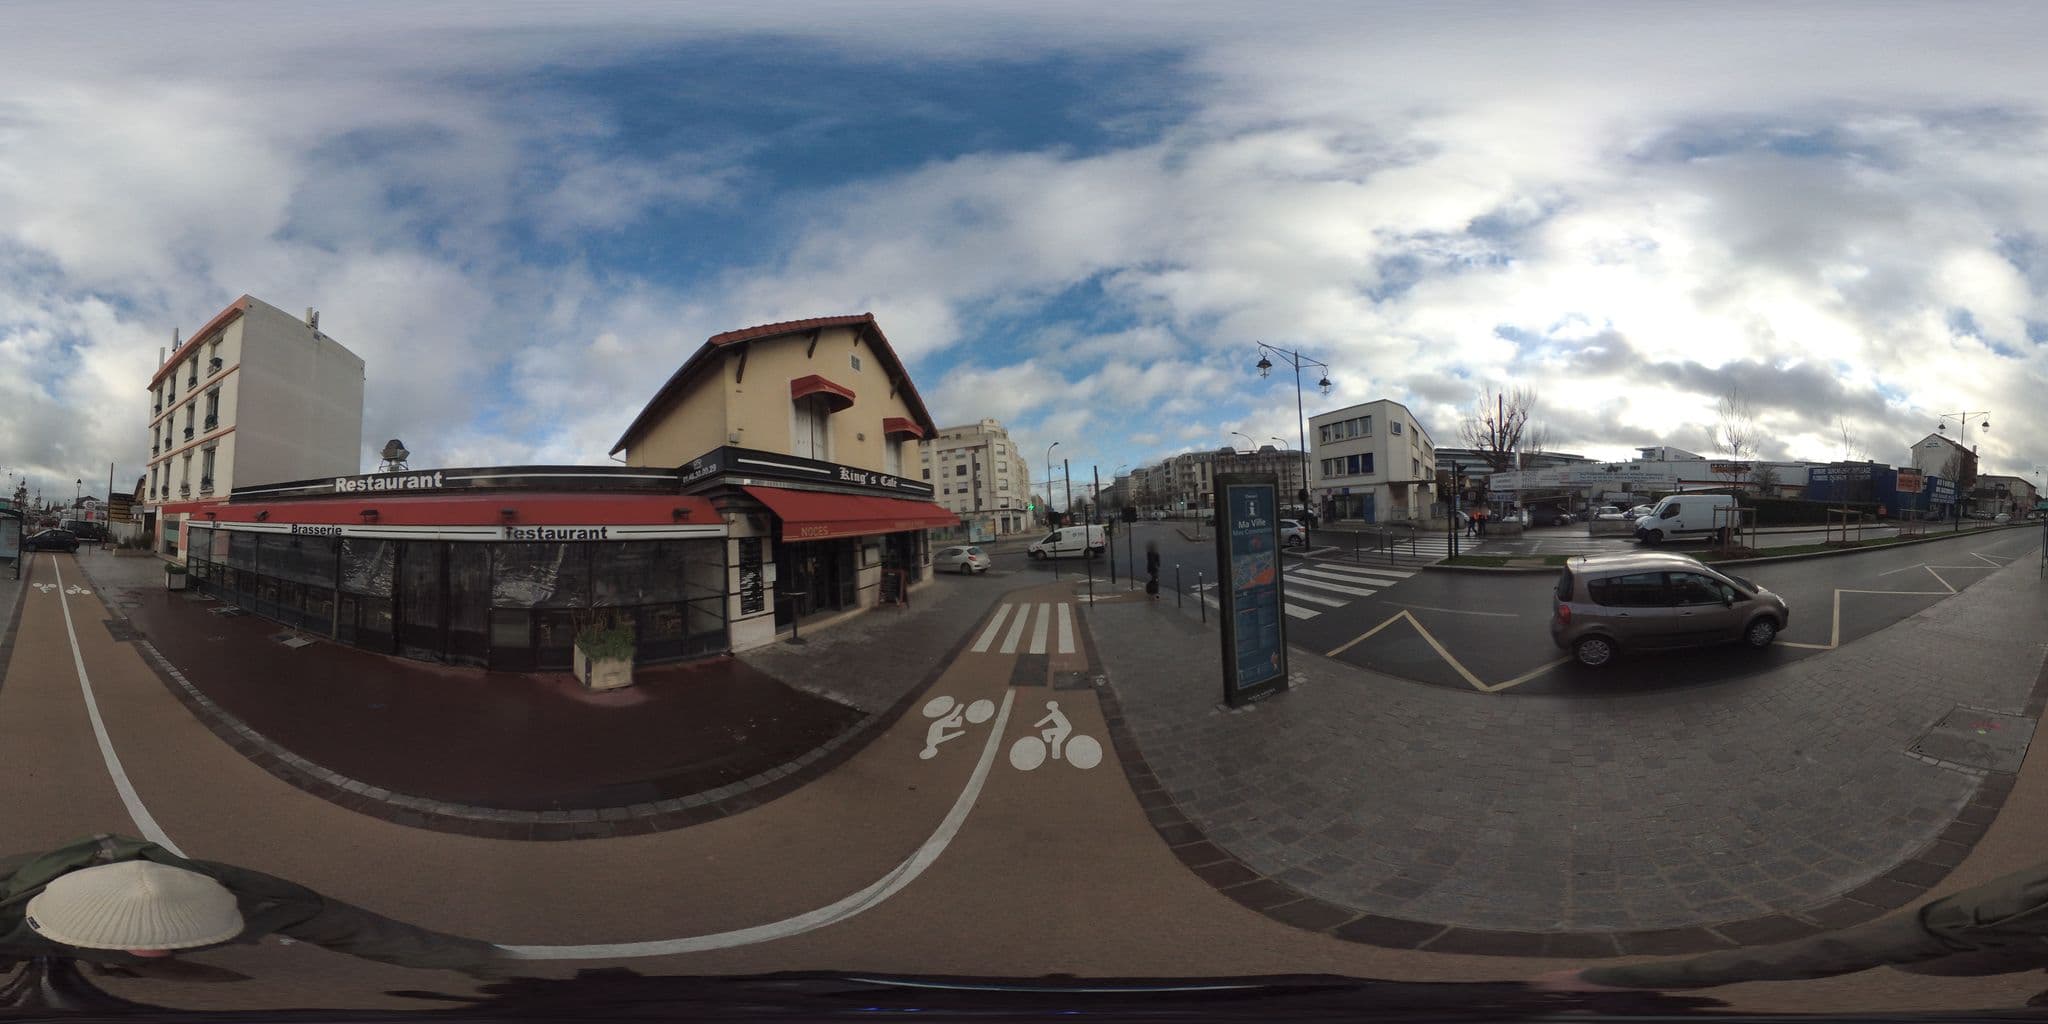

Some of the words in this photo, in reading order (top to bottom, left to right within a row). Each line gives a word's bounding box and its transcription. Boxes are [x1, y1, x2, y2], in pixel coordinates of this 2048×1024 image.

[335, 471, 443, 493] Restaurant
[291, 523, 343, 536] Brasserie
[1238, 520, 1250, 529] Ma
[1251, 518, 1266, 528] Ville
